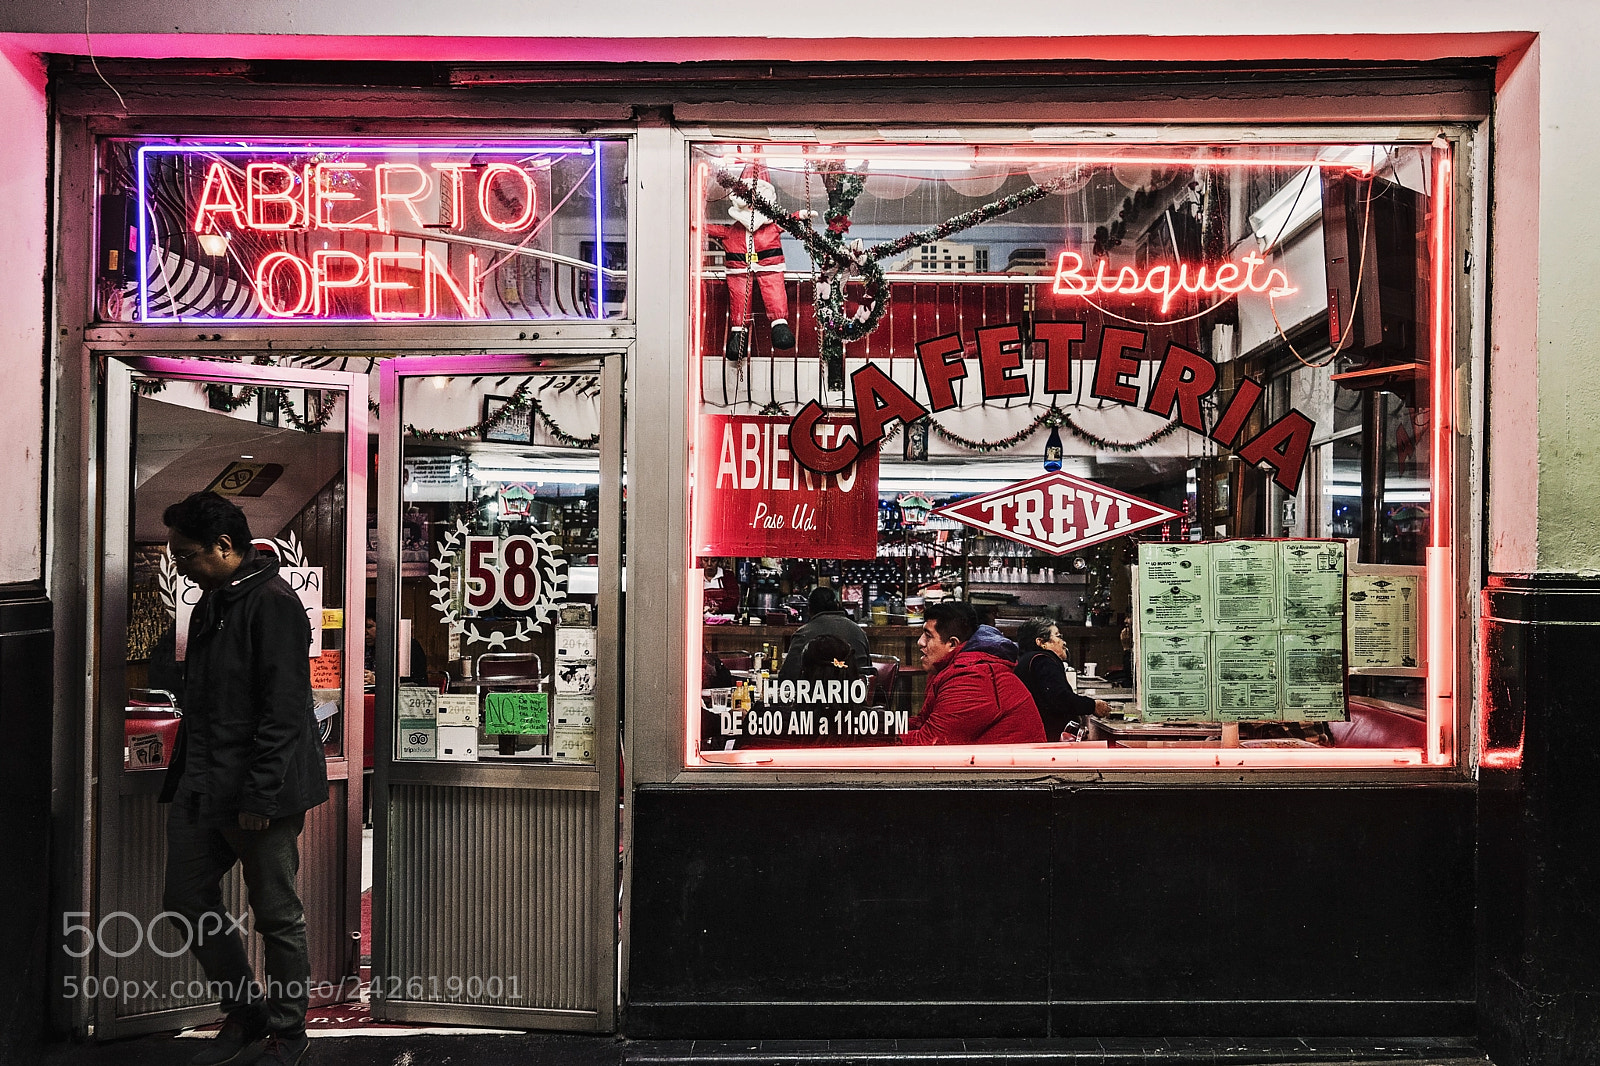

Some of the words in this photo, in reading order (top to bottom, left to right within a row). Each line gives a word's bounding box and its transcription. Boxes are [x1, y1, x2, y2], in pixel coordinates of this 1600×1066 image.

[194, 161, 537, 233] ABIERTO
[253, 250, 483, 319] OPEN
[1052, 250, 1299, 314] Bisquets
[787, 320, 1317, 497] CAFETERIA
[981, 483, 1132, 545] TREVI
[465, 535, 541, 611] 58
[409, 698, 433, 708] 2017
[720, 710, 743, 735] DE
[747, 710, 783, 736] 8:00
[787, 710, 814, 736] AM
[818, 717, 829, 736] a
[833, 710, 879, 736] 11:00
[884, 710, 909, 736] PM
[763, 679, 867, 705] HORARIO
